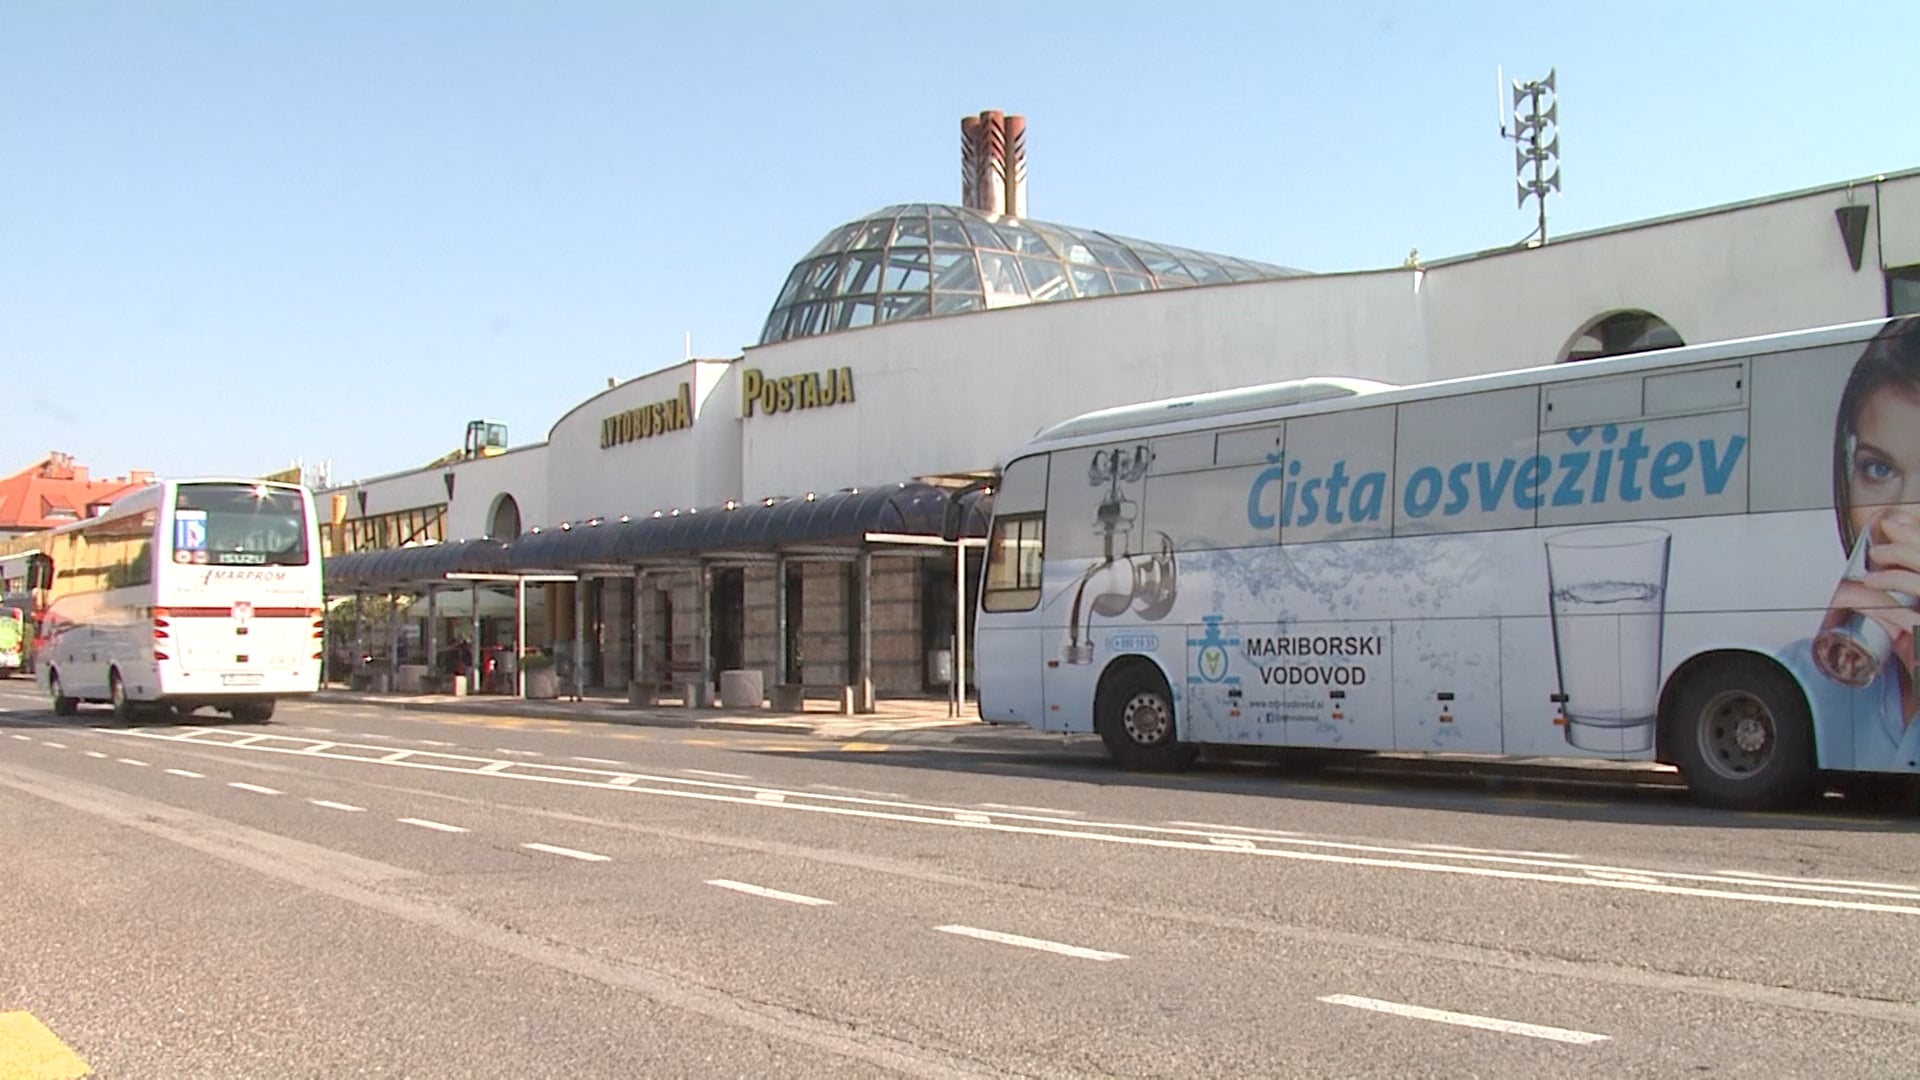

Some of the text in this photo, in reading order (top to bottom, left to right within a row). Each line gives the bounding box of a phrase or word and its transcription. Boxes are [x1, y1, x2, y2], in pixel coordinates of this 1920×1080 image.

[742, 367, 855, 417] POSTAJA
[600, 382, 693, 449] AVTOBUSNA
[1247, 423, 1747, 530] Čista osvežitev
[220, 553, 266, 564] ISUZU
[215, 570, 286, 581] MARPROM
[1247, 636, 1382, 656] MARIBORSKI
[1259, 666, 1366, 685] VODOVOD
